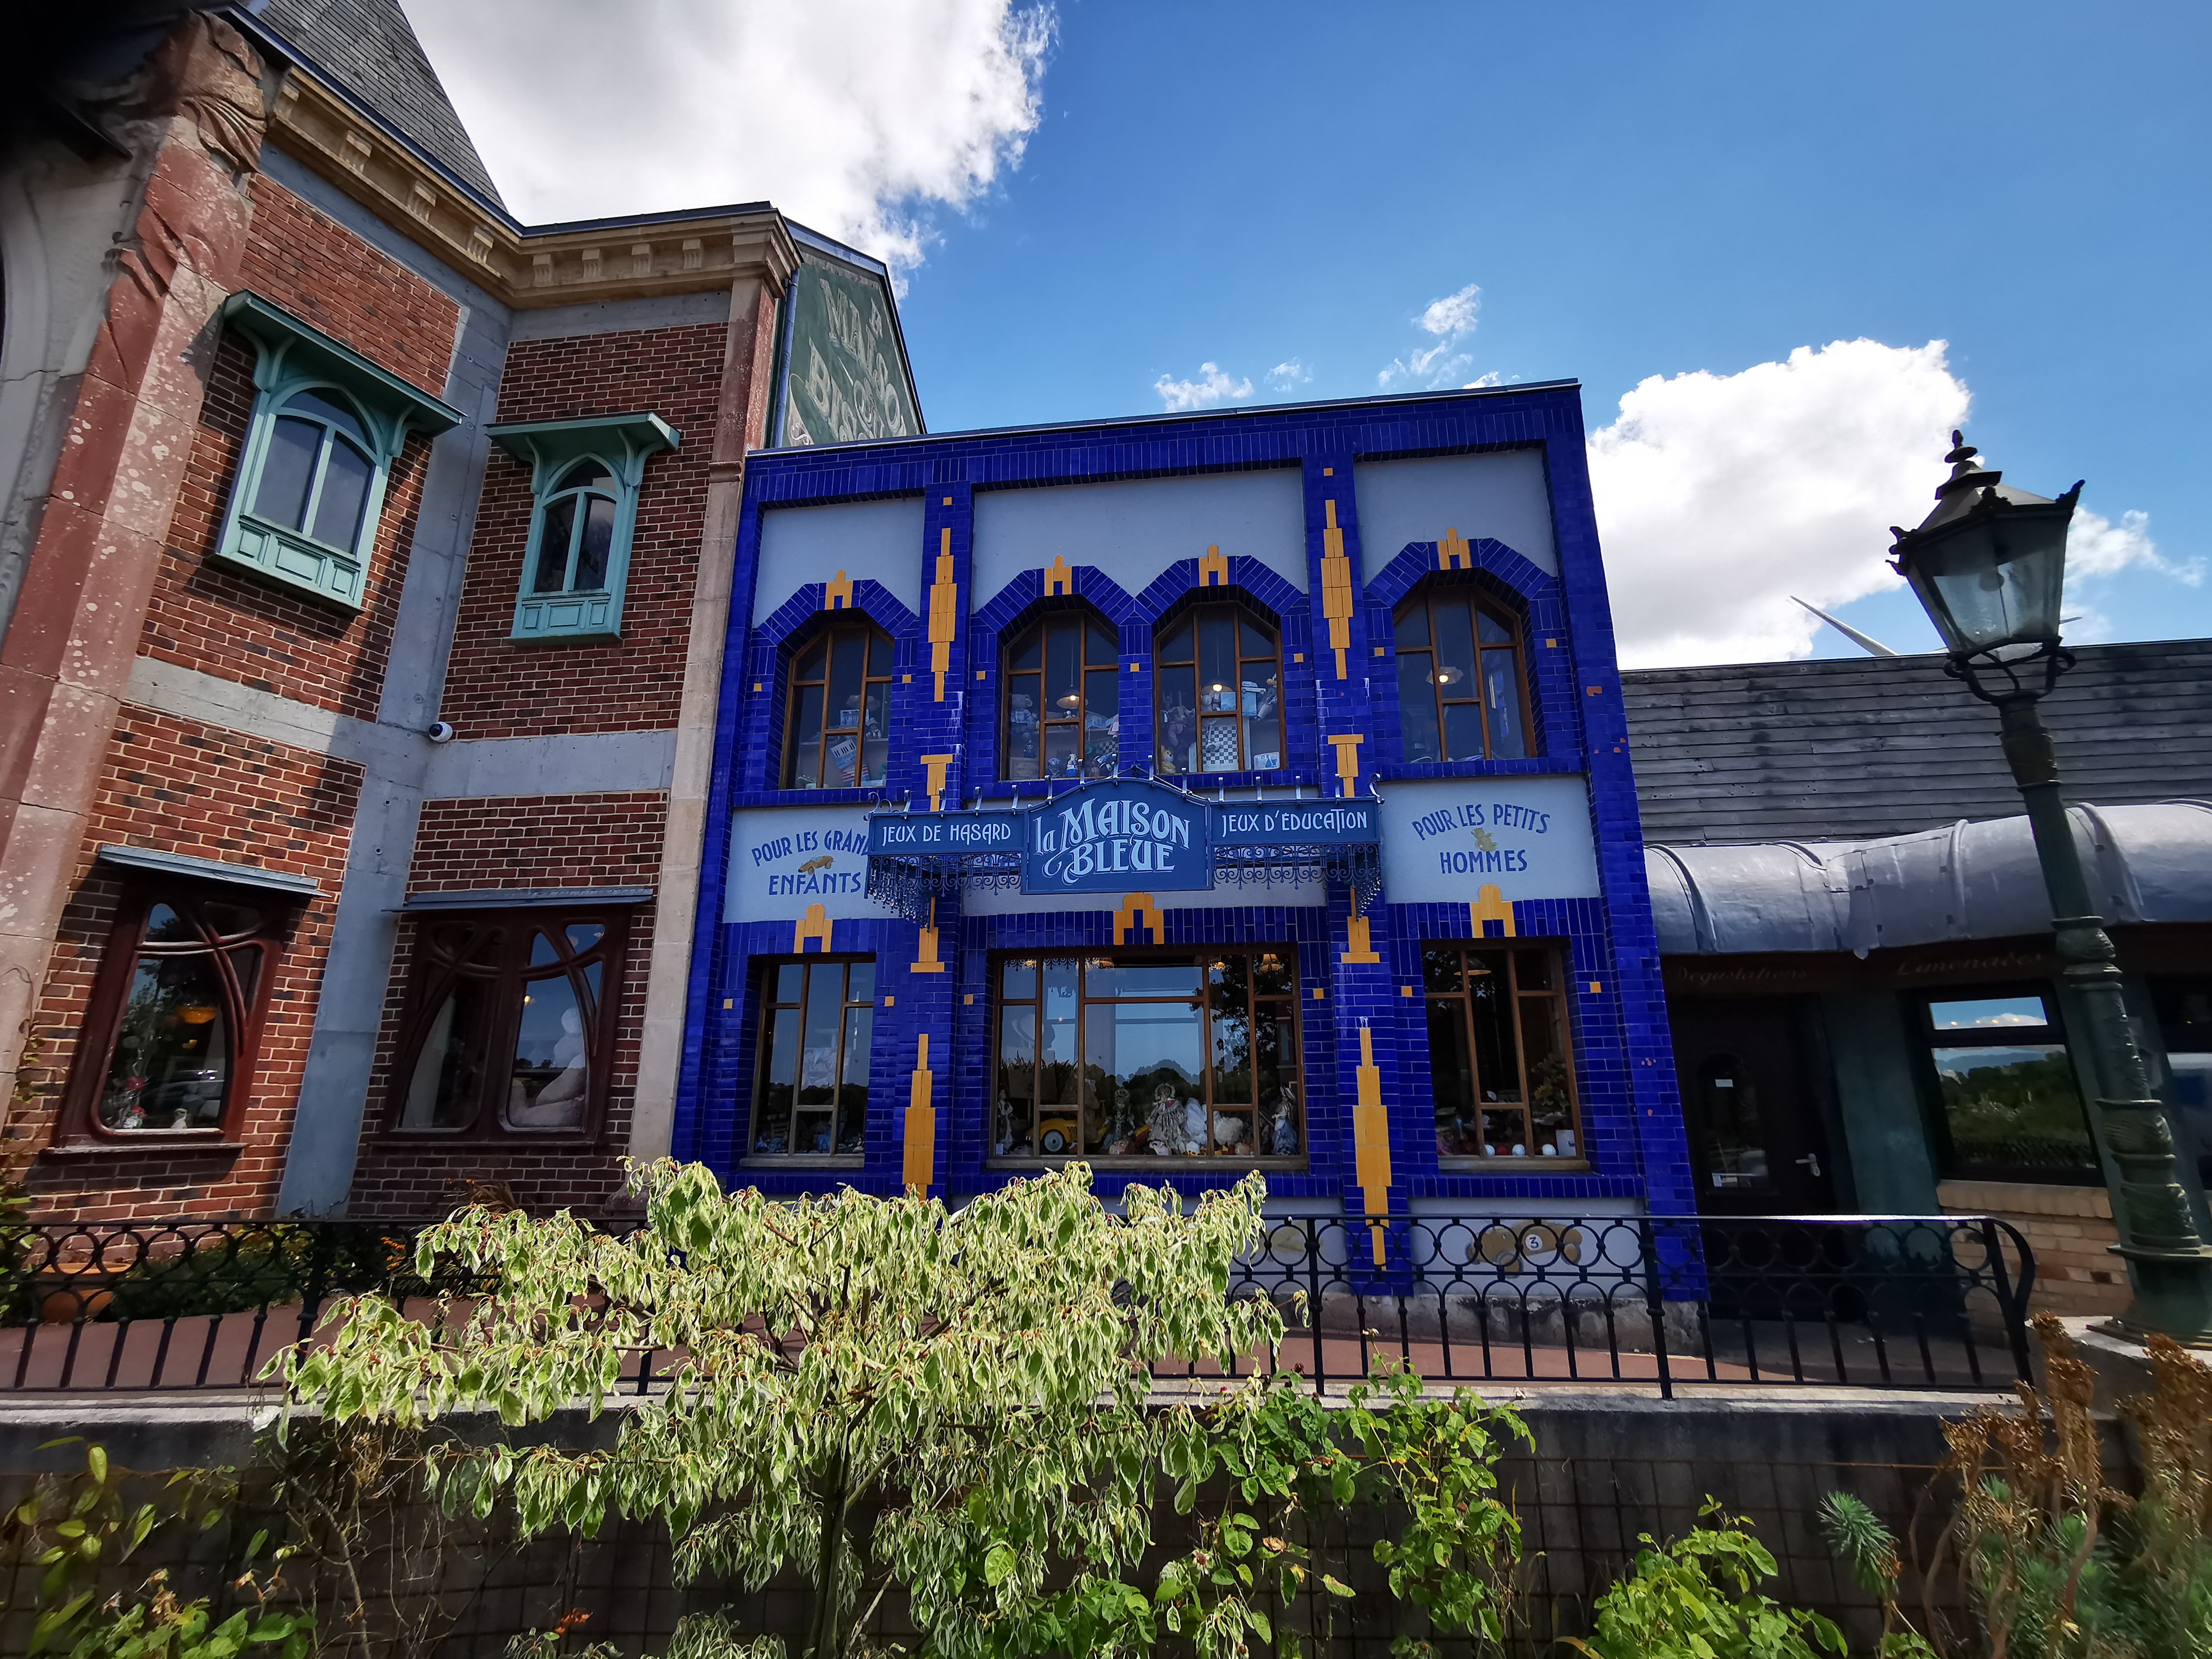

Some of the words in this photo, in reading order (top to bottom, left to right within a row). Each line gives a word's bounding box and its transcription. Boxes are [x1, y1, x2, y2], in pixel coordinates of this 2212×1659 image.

[820, 278, 907, 437] MAISO
[805, 337, 869, 442] BIS
[882, 825, 916, 847] JEUX
[923, 825, 941, 842] DE
[950, 823, 1011, 845] HASARD
[1048, 798, 1191, 864] MAISON
[1222, 814, 1260, 838] JEUX
[1265, 809, 1367, 833] D'ÉDUCATION
[1411, 809, 1458, 841] POUR
[1456, 804, 1485, 828] LES
[1493, 803, 1551, 834] PETITS
[751, 836, 792, 867] POUR
[796, 830, 818, 852] LES
[824, 828, 869, 856] GRAN
[1062, 834, 1175, 886] BLEUE
[1440, 849, 1528, 874] HOMMES
[769, 871, 861, 896] ENFANTS
[1529, 1236, 1539, 1249] 3
